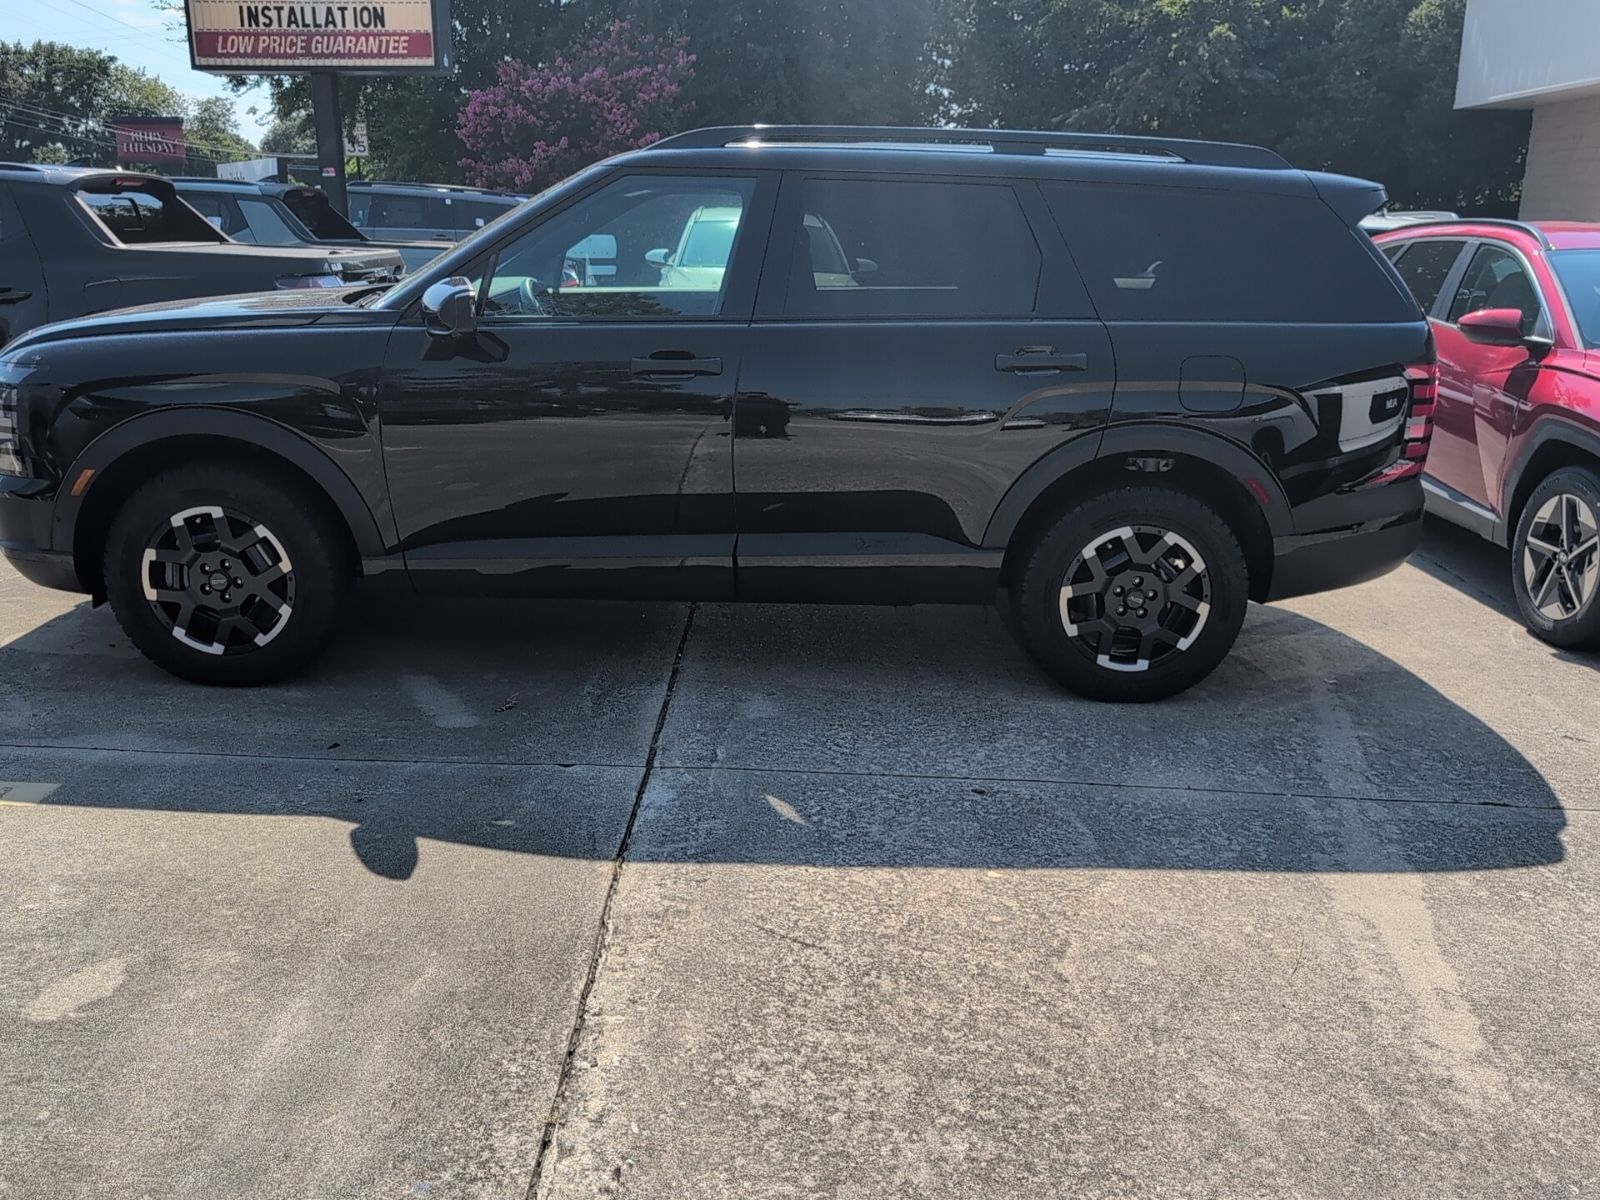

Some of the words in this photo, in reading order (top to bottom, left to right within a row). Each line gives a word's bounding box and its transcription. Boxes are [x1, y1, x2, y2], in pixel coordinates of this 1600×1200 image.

[239, 5, 385, 28] INSTALLATION
[217, 35, 254, 54] LOW
[258, 35, 307, 54] PRICE
[311, 35, 409, 54] GUARANTEE
[123, 142, 174, 153] TUESDAY
[346, 138, 366, 153] 35
